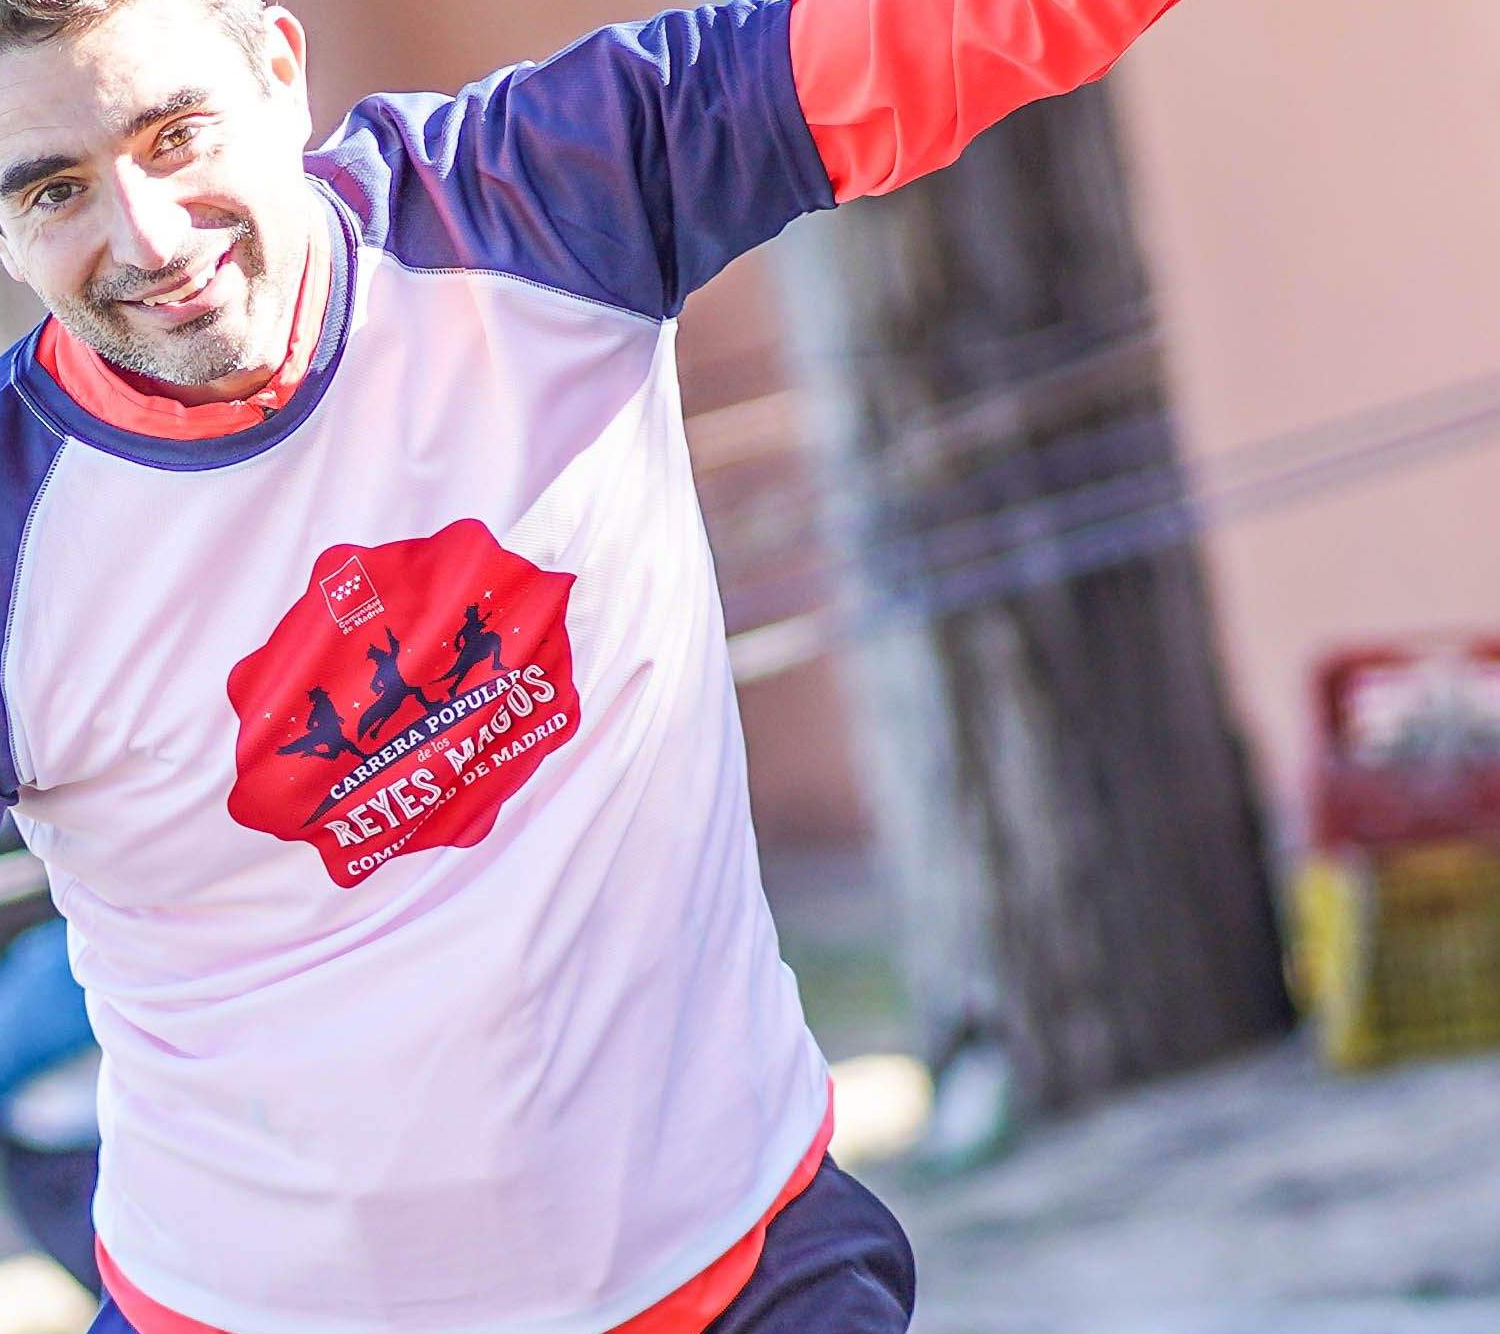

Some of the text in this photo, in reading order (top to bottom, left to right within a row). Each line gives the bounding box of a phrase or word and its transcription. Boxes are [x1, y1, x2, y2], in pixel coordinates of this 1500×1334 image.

[342, 604, 385, 635] de Madrid
[325, 664, 555, 847] REYES MAGOS
[330, 730, 425, 800] CARRERA
[416, 737, 450, 763] de los
[462, 762, 490, 786] DE
[493, 712, 568, 768] MADRID
